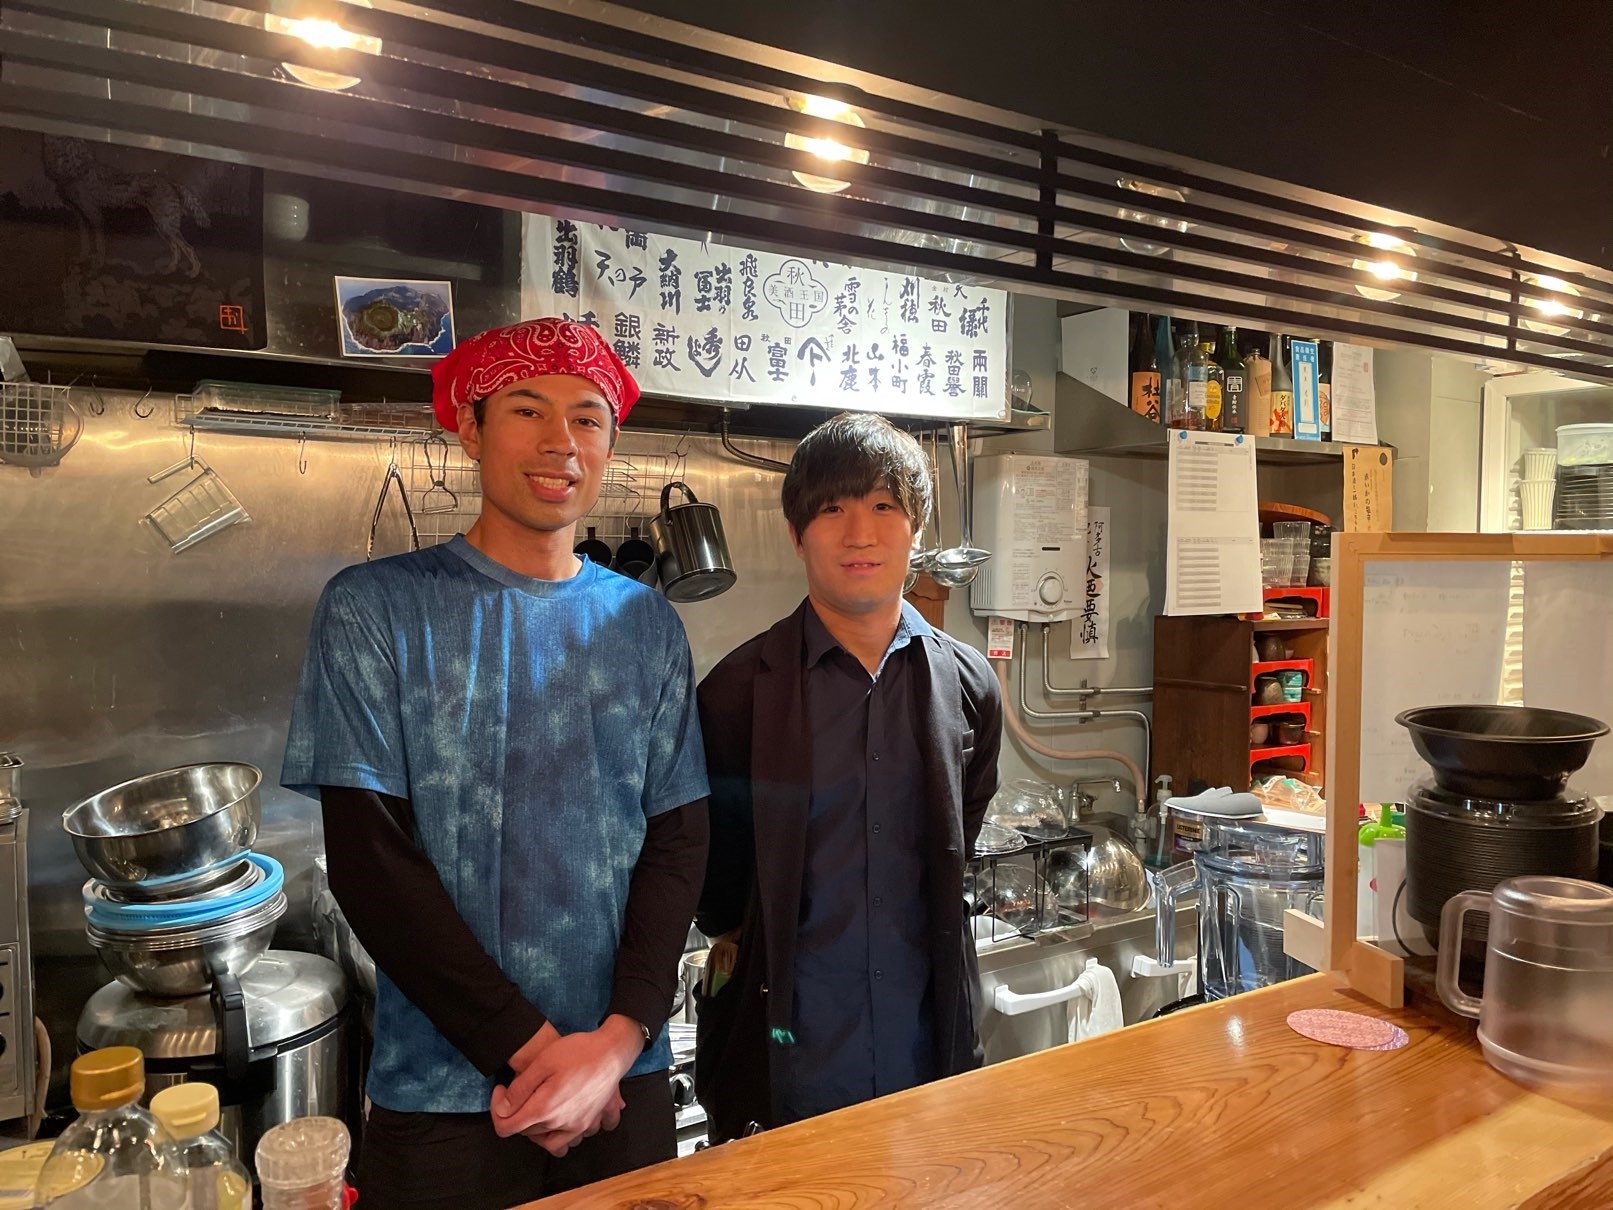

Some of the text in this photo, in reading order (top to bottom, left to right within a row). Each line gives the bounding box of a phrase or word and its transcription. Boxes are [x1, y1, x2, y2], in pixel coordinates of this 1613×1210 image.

[552, 220, 580, 298] 出羽鶴
[768, 284, 825, 305] 美酒王国
[927, 293, 952, 334] 秋田
[651, 322, 682, 373] 新政
[891, 334, 910, 395] 福小町
[914, 341, 937, 397] 春霞
